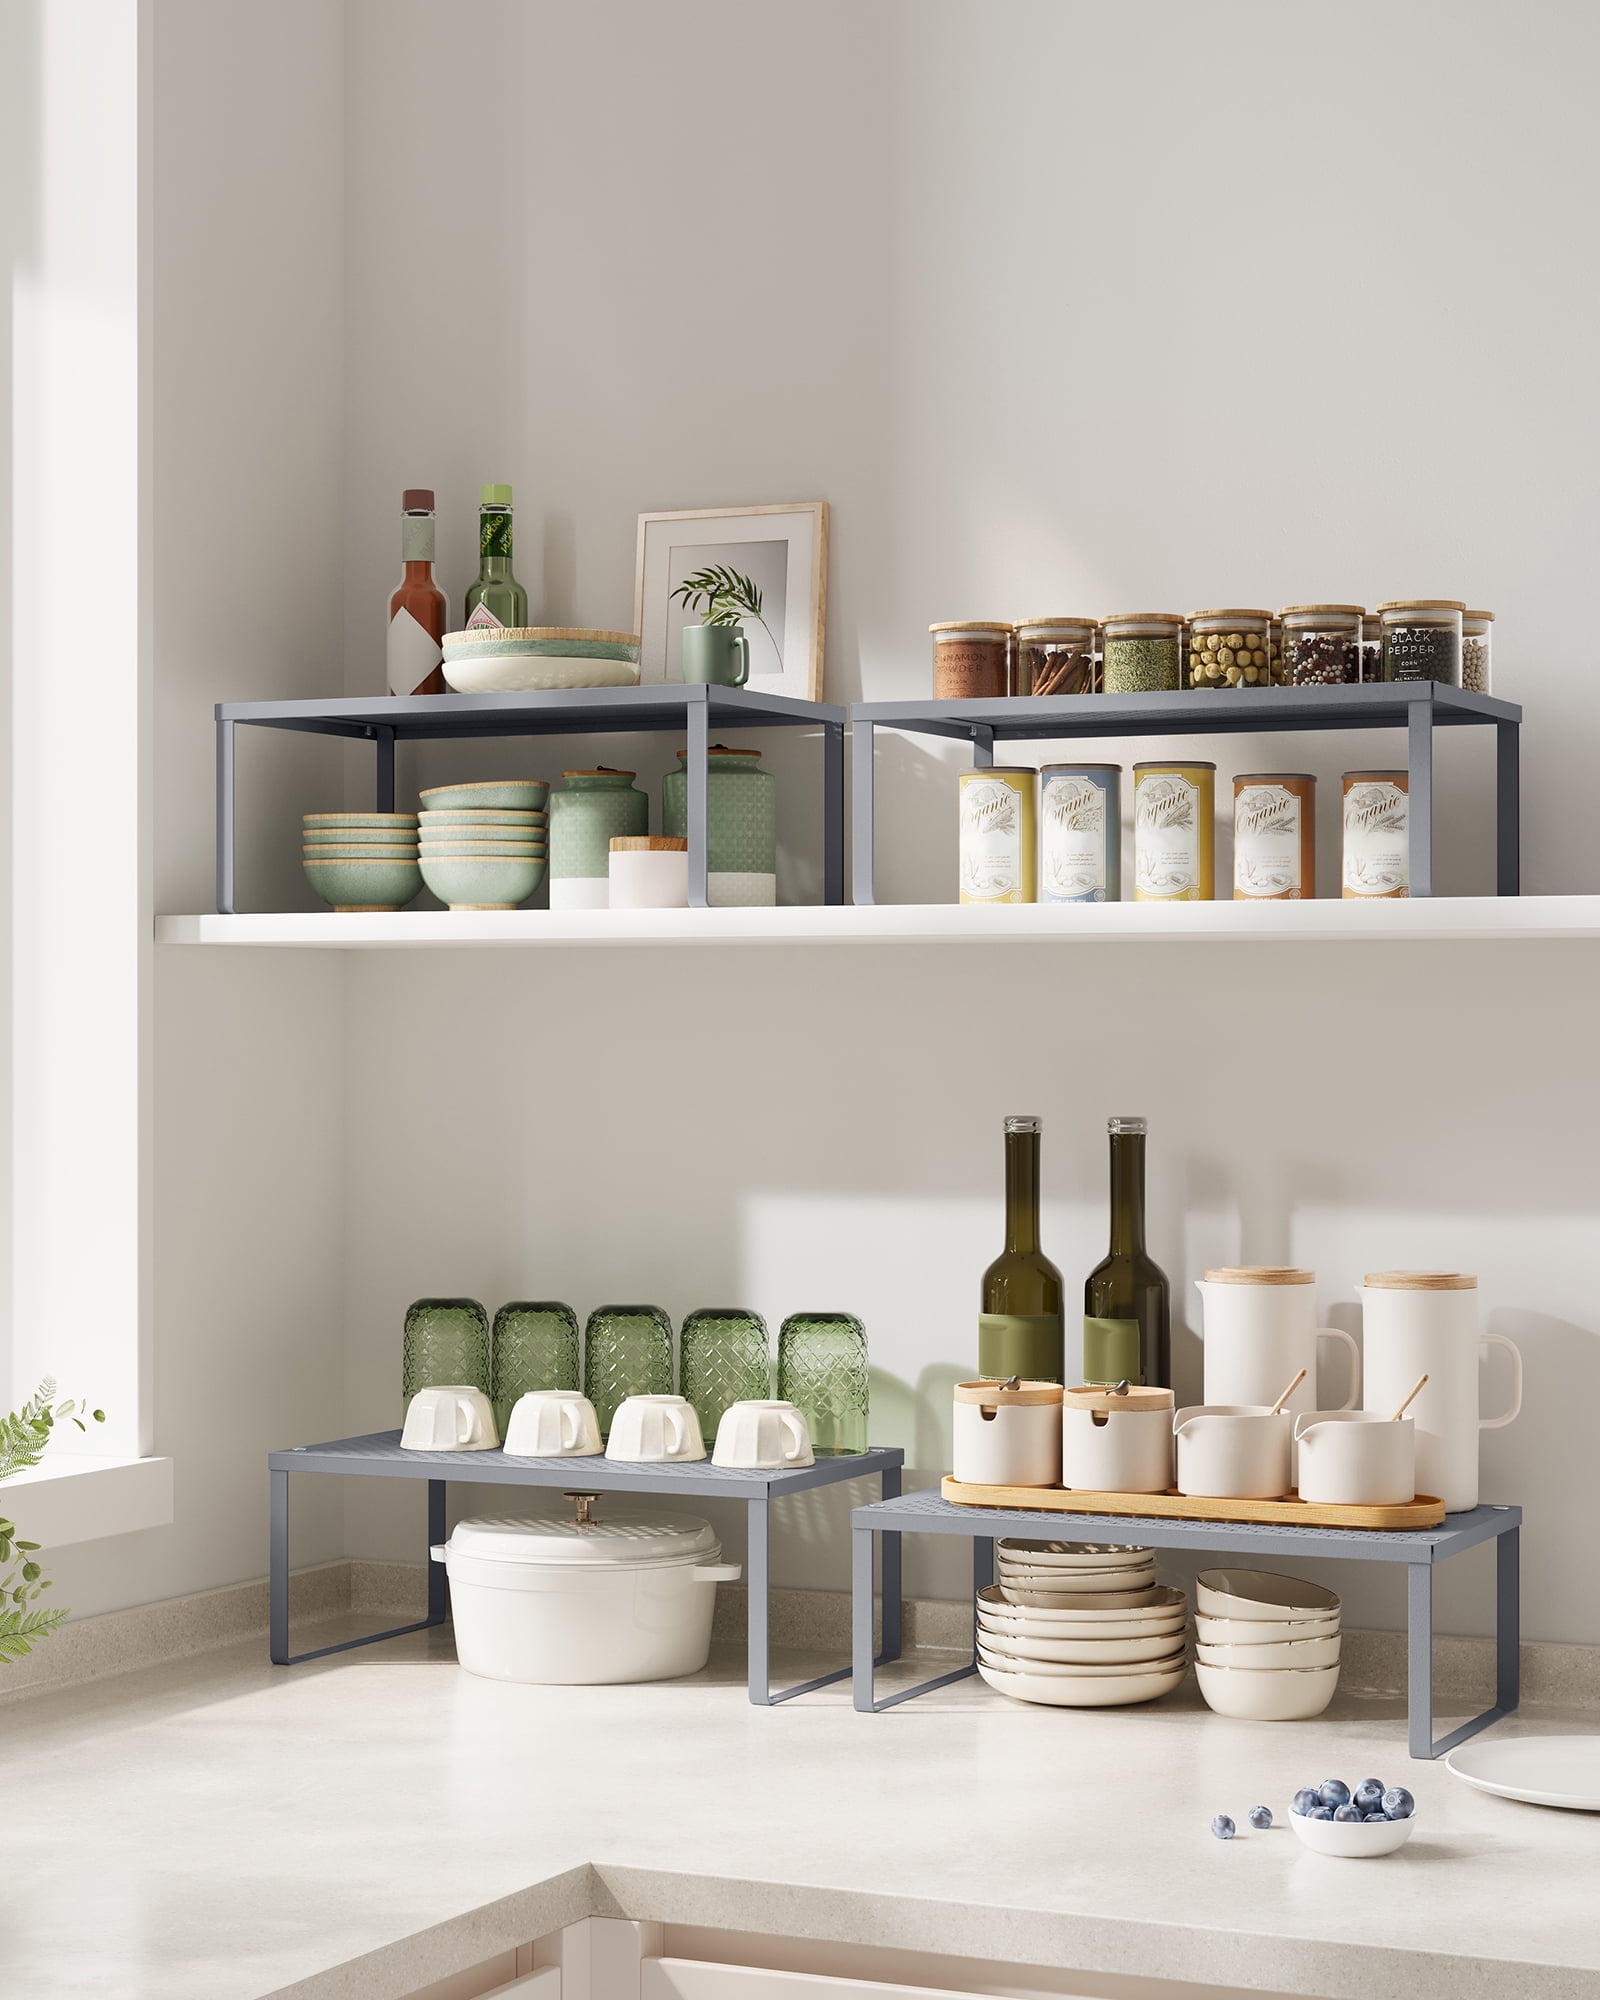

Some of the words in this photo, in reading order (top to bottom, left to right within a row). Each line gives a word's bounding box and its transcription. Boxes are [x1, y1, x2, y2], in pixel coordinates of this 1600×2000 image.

[1391, 633, 1431, 643] BLACK
[1388, 645, 1435, 656] PEPPER
[934, 653, 987, 663] CINNAMON
[1236, 797, 1290, 832] Organic
[1345, 794, 1400, 831] Organic
